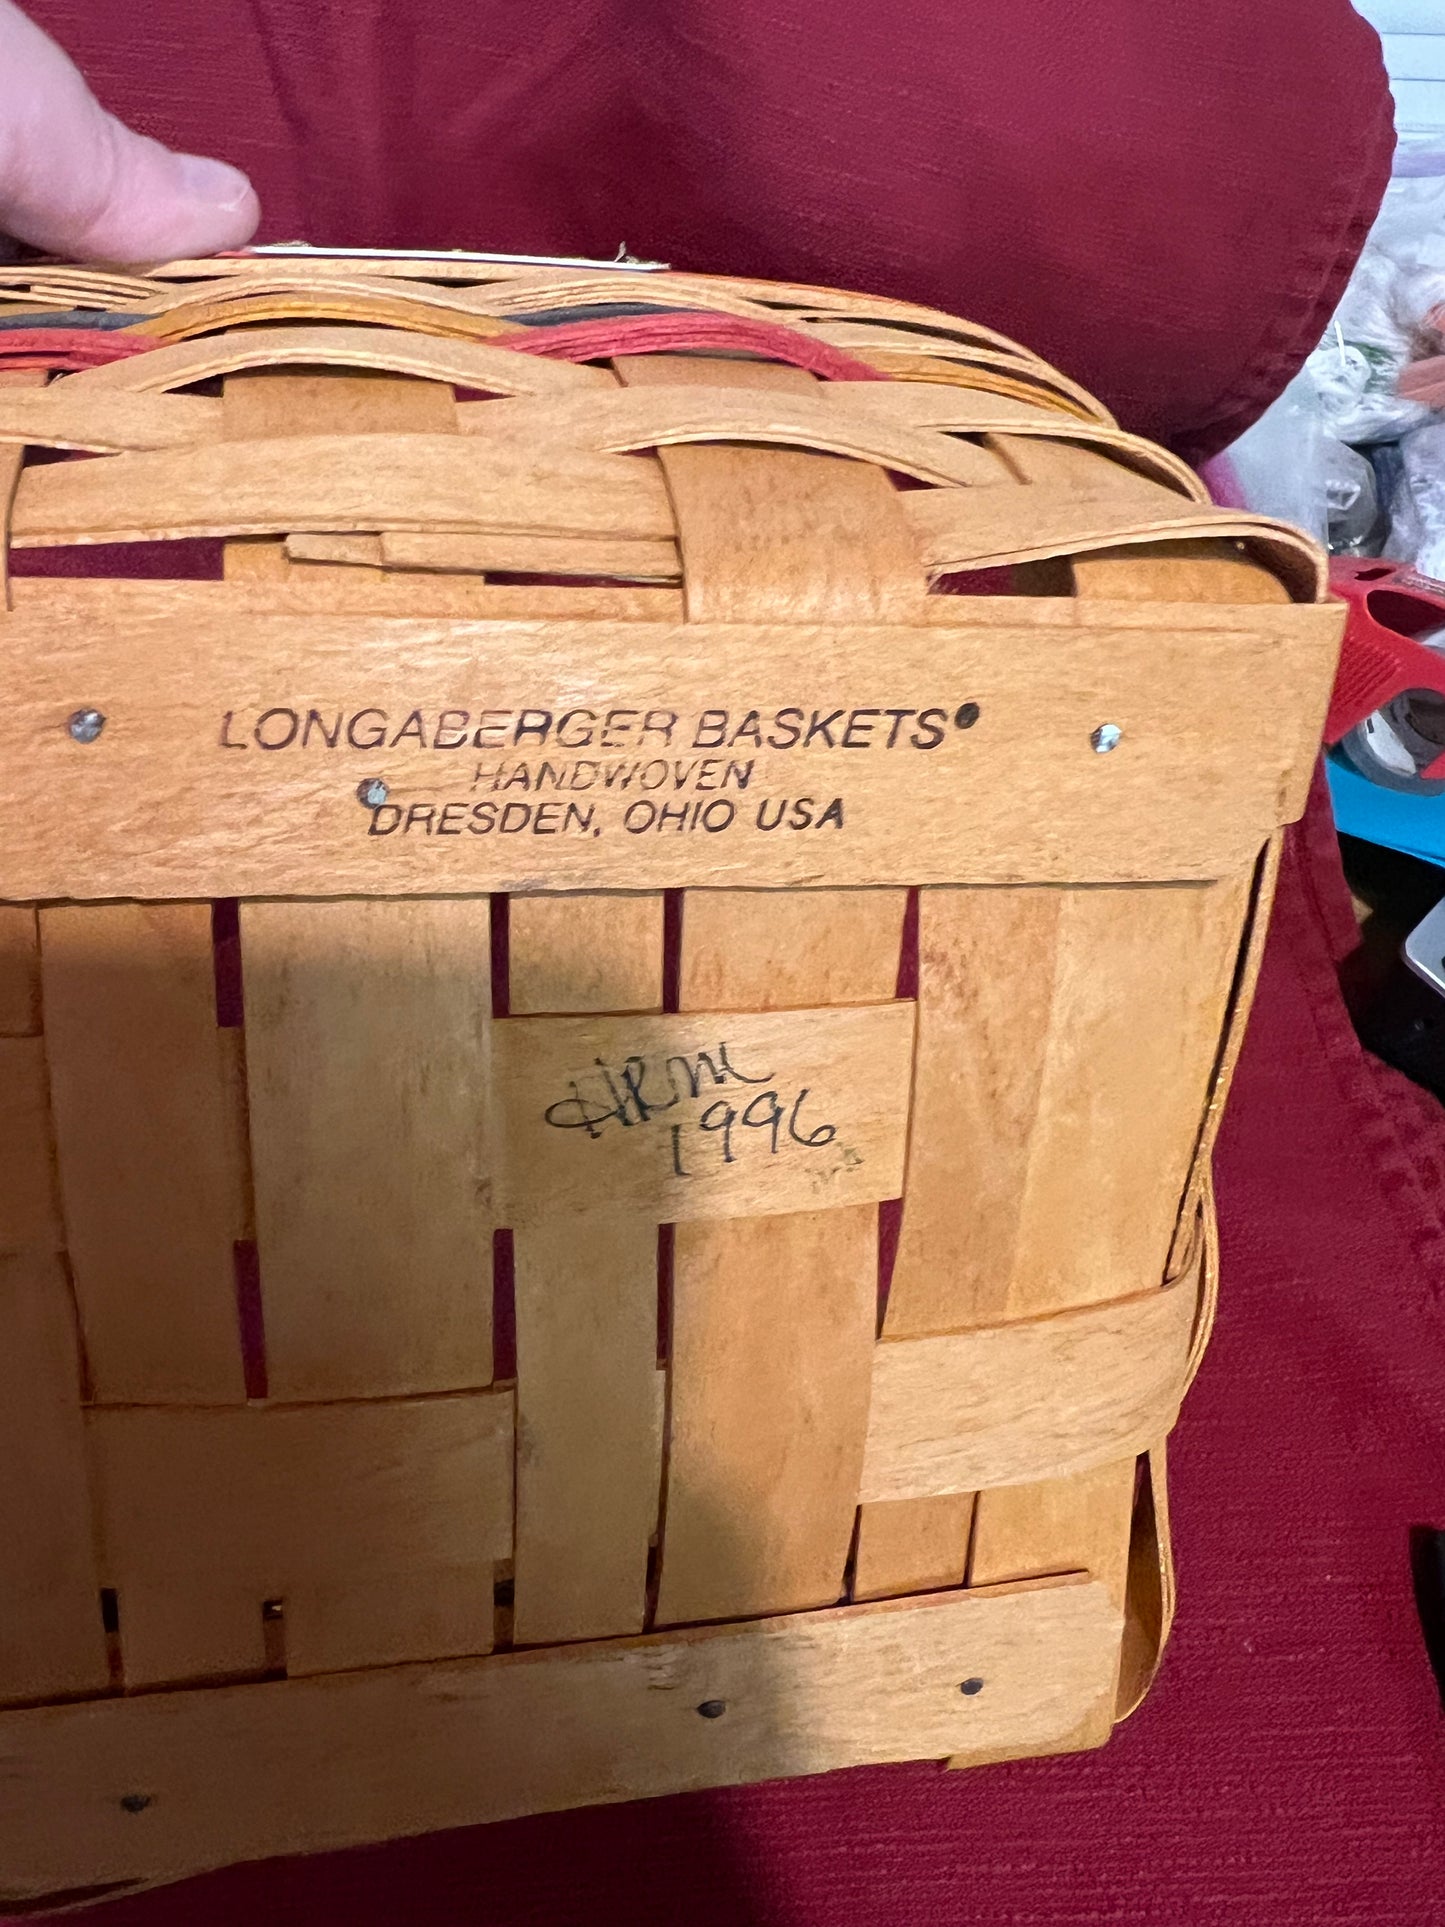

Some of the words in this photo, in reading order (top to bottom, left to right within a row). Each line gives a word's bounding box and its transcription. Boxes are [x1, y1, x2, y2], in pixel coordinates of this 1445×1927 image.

[218, 708, 679, 751] LONGABERGER
[472, 759, 755, 793] HANDWOVEN
[367, 802, 602, 837] DRESDEN,
[624, 799, 735, 835] OHIO
[755, 798, 845, 833] USA
[670, 1088, 837, 1176] 1996
